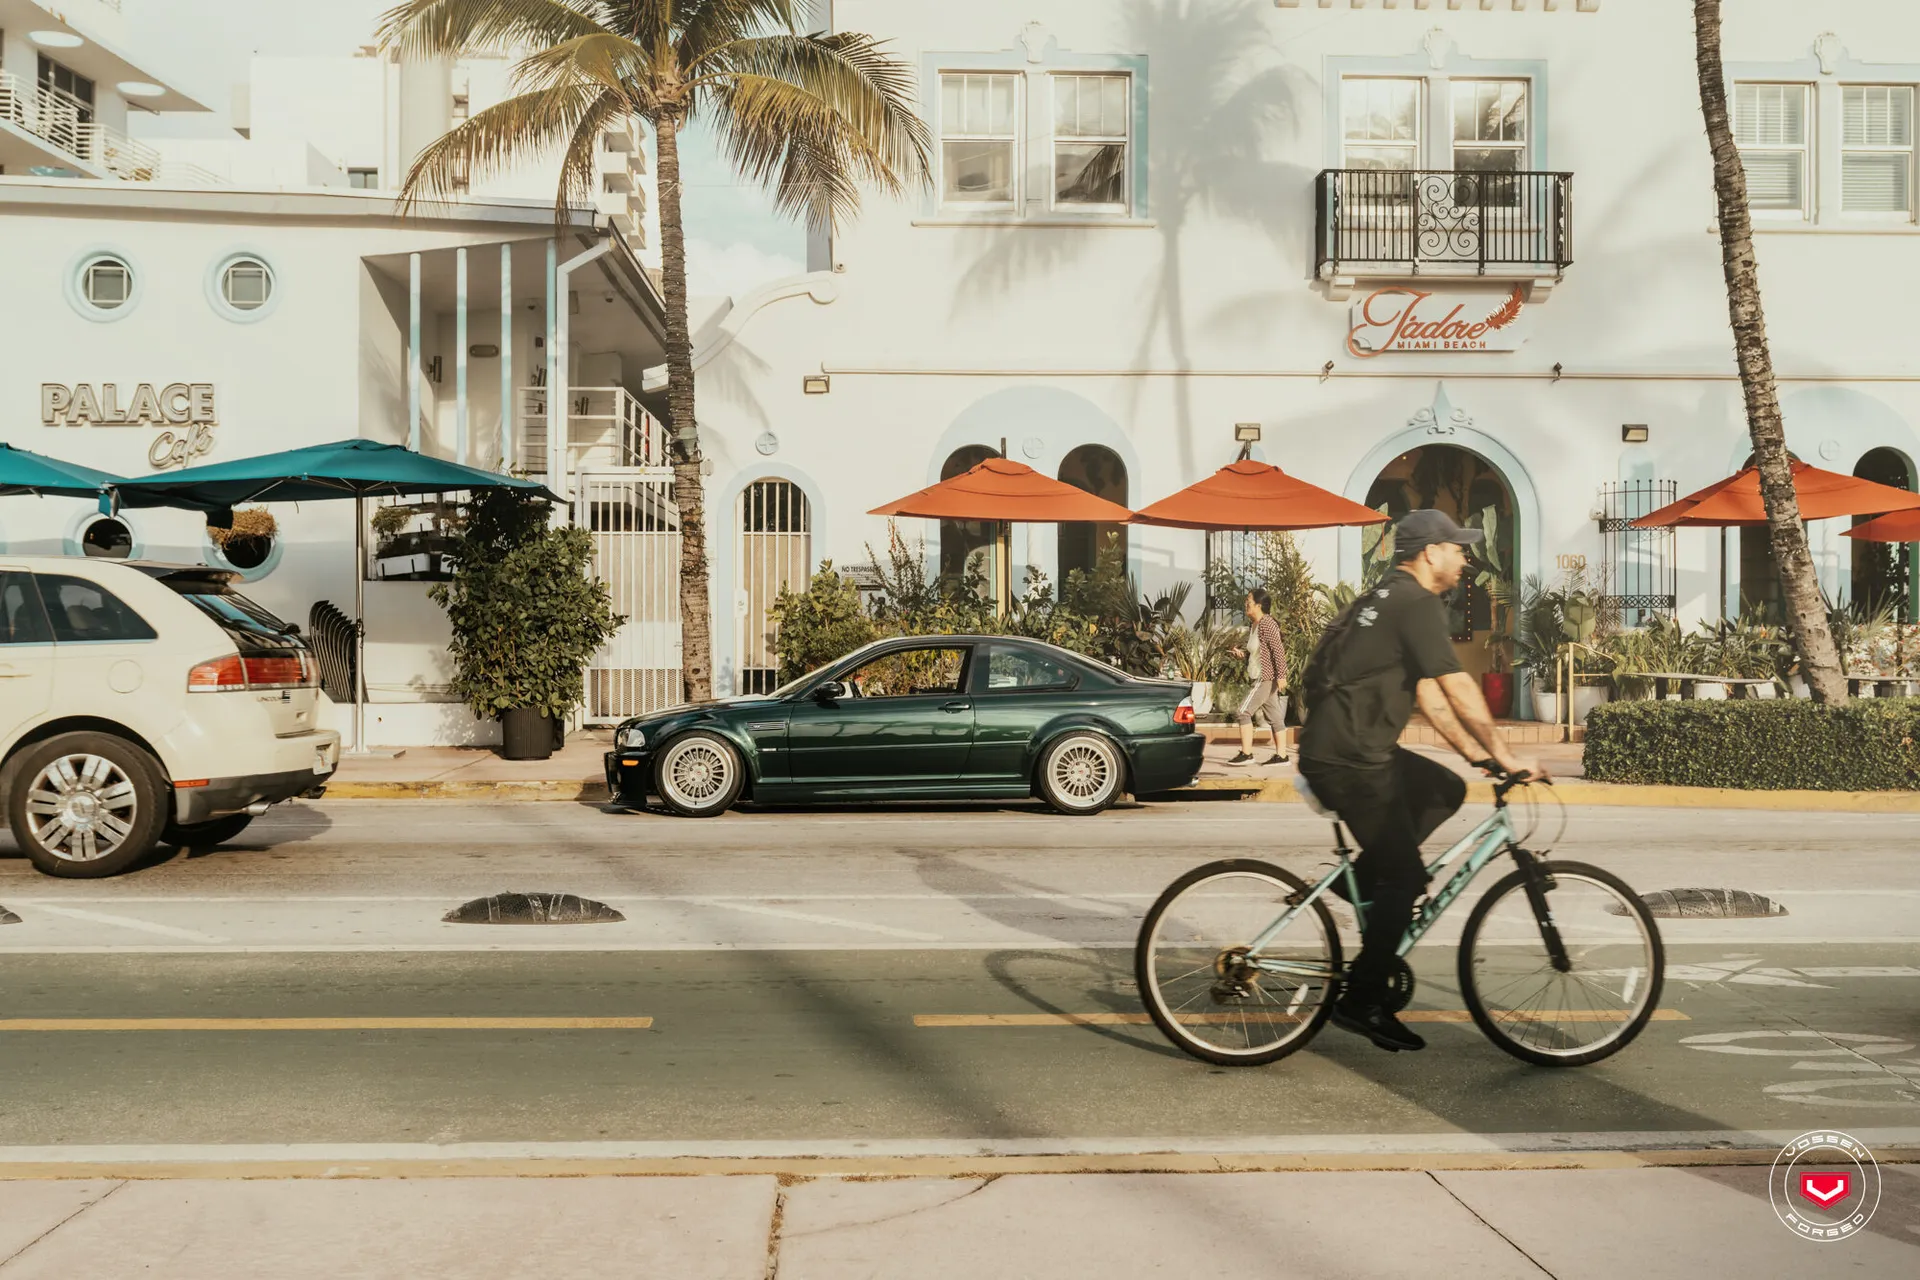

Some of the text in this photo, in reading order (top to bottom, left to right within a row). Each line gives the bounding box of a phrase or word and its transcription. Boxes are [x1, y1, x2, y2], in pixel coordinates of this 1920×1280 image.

[1397, 341, 1487, 349] MIAMI BEACH
[41, 383, 217, 425] PALACE
[1556, 554, 1586, 569] 1060
